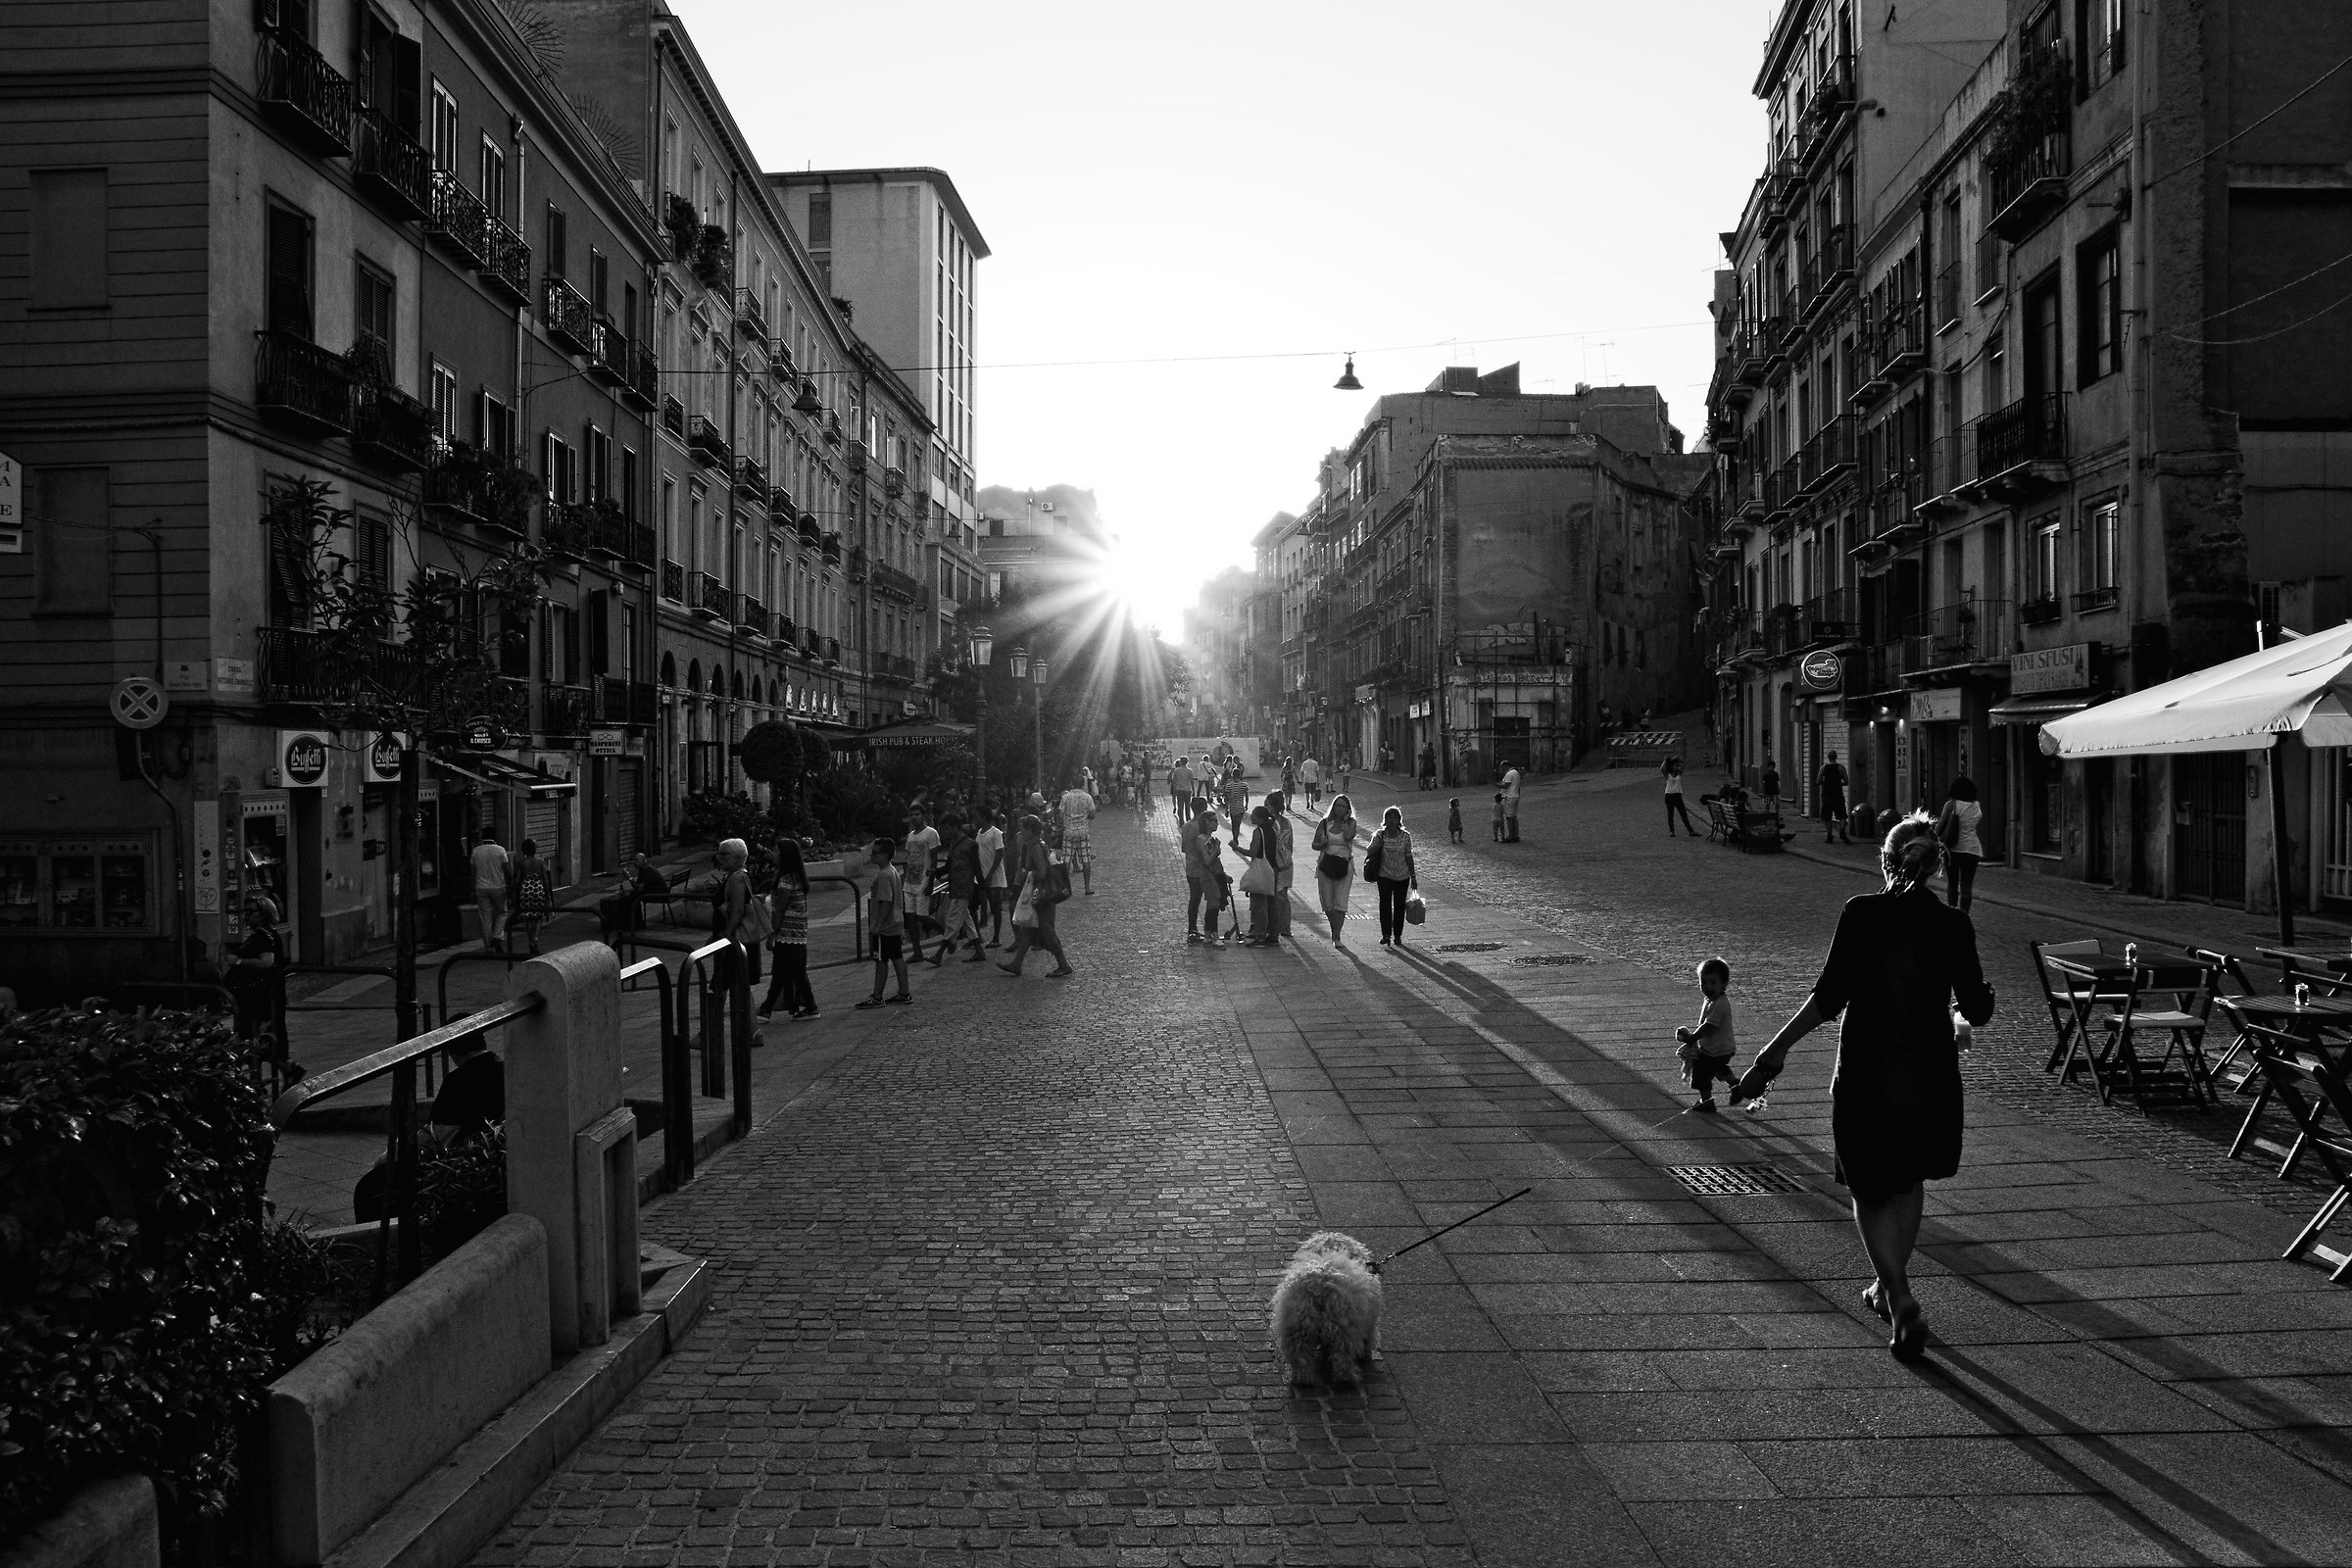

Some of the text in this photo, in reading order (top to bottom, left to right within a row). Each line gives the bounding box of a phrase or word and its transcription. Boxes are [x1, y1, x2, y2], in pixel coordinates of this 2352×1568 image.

[2012, 648, 2074, 671] VINI SFUSI
[869, 737, 888, 747] IRISH
[889, 737, 904, 746] PUB
[905, 736, 910, 746] &
[911, 736, 933, 746] STEAK
